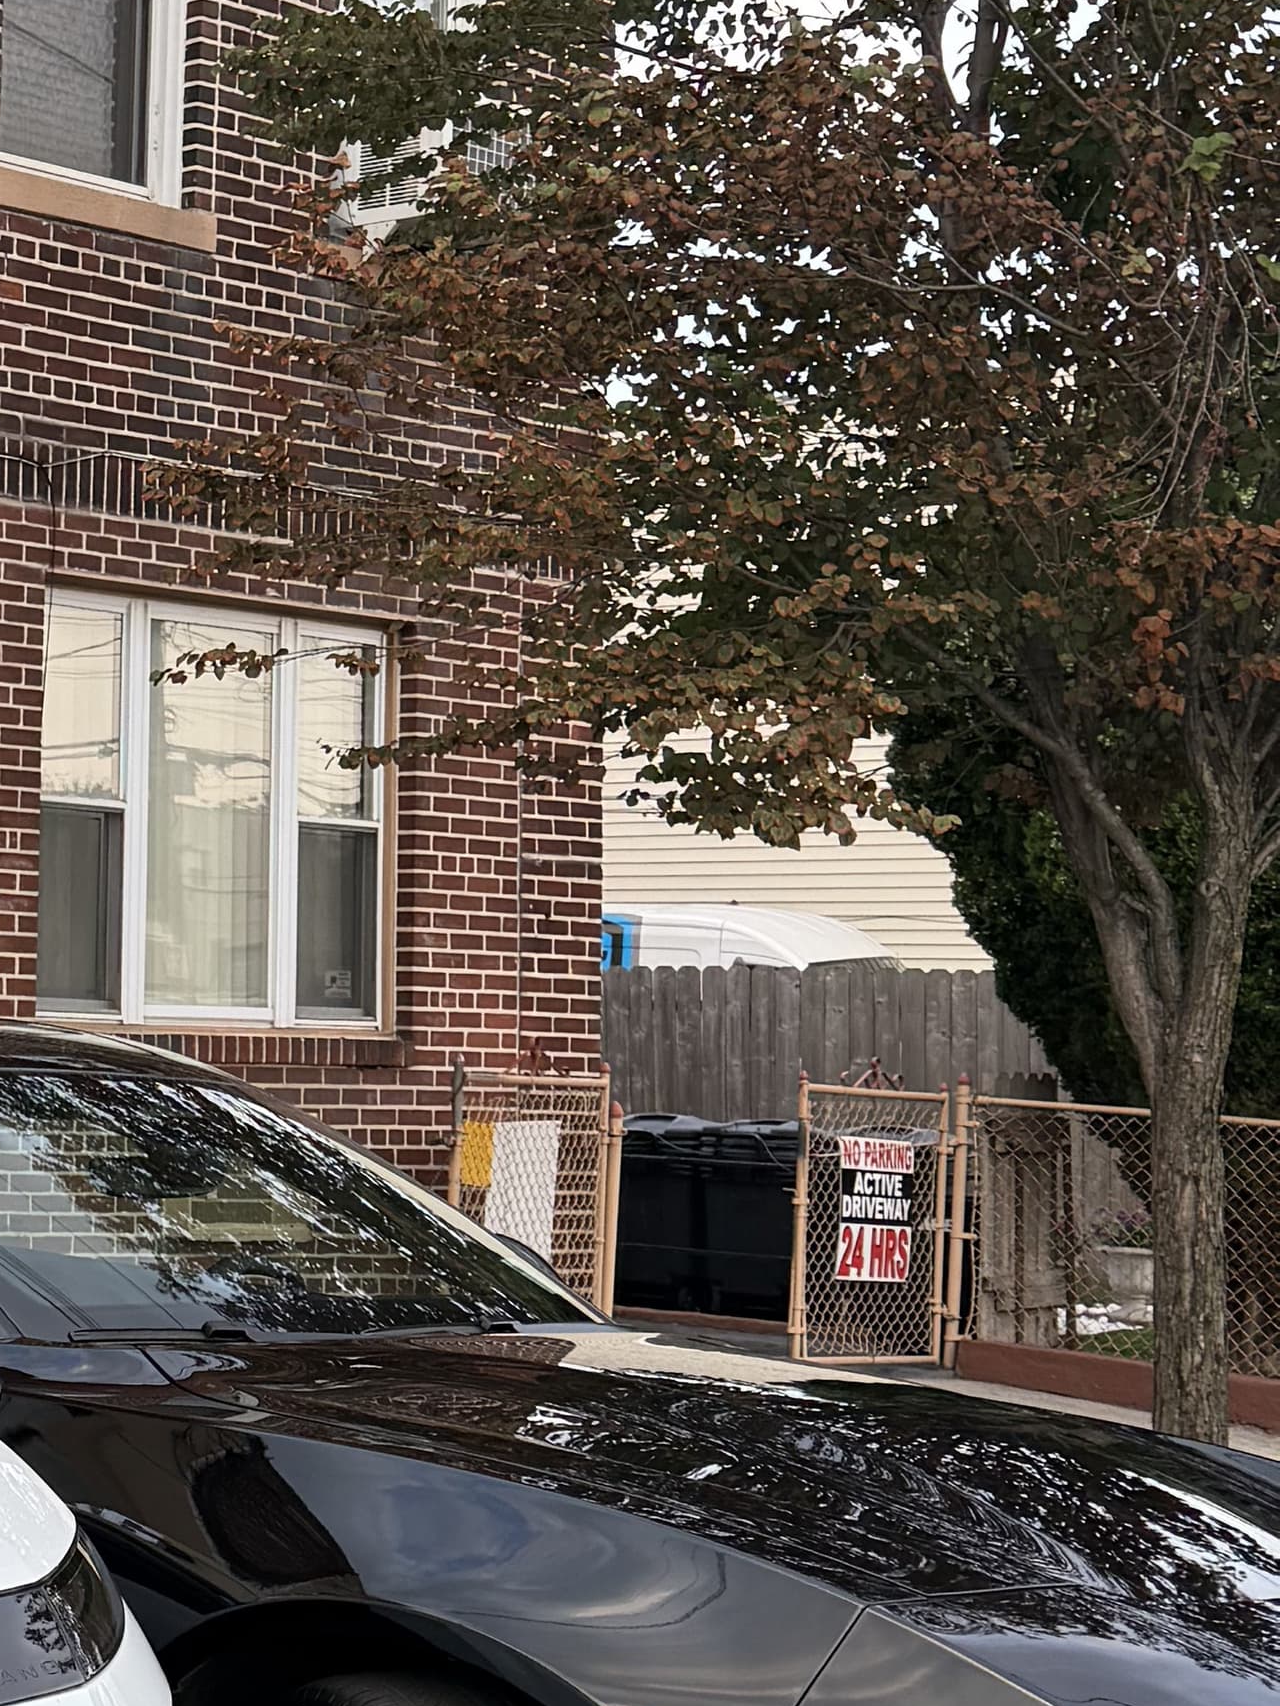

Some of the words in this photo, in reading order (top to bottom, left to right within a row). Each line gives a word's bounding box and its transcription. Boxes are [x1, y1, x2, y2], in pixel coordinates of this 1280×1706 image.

[842, 1139, 861, 1166] NO
[863, 1140, 913, 1171] PARKING
[853, 1171, 903, 1197] ACTIVE
[842, 1195, 911, 1221] DRIVEWAY
[838, 1225, 864, 1277] 24
[869, 1227, 909, 1279] HRS
